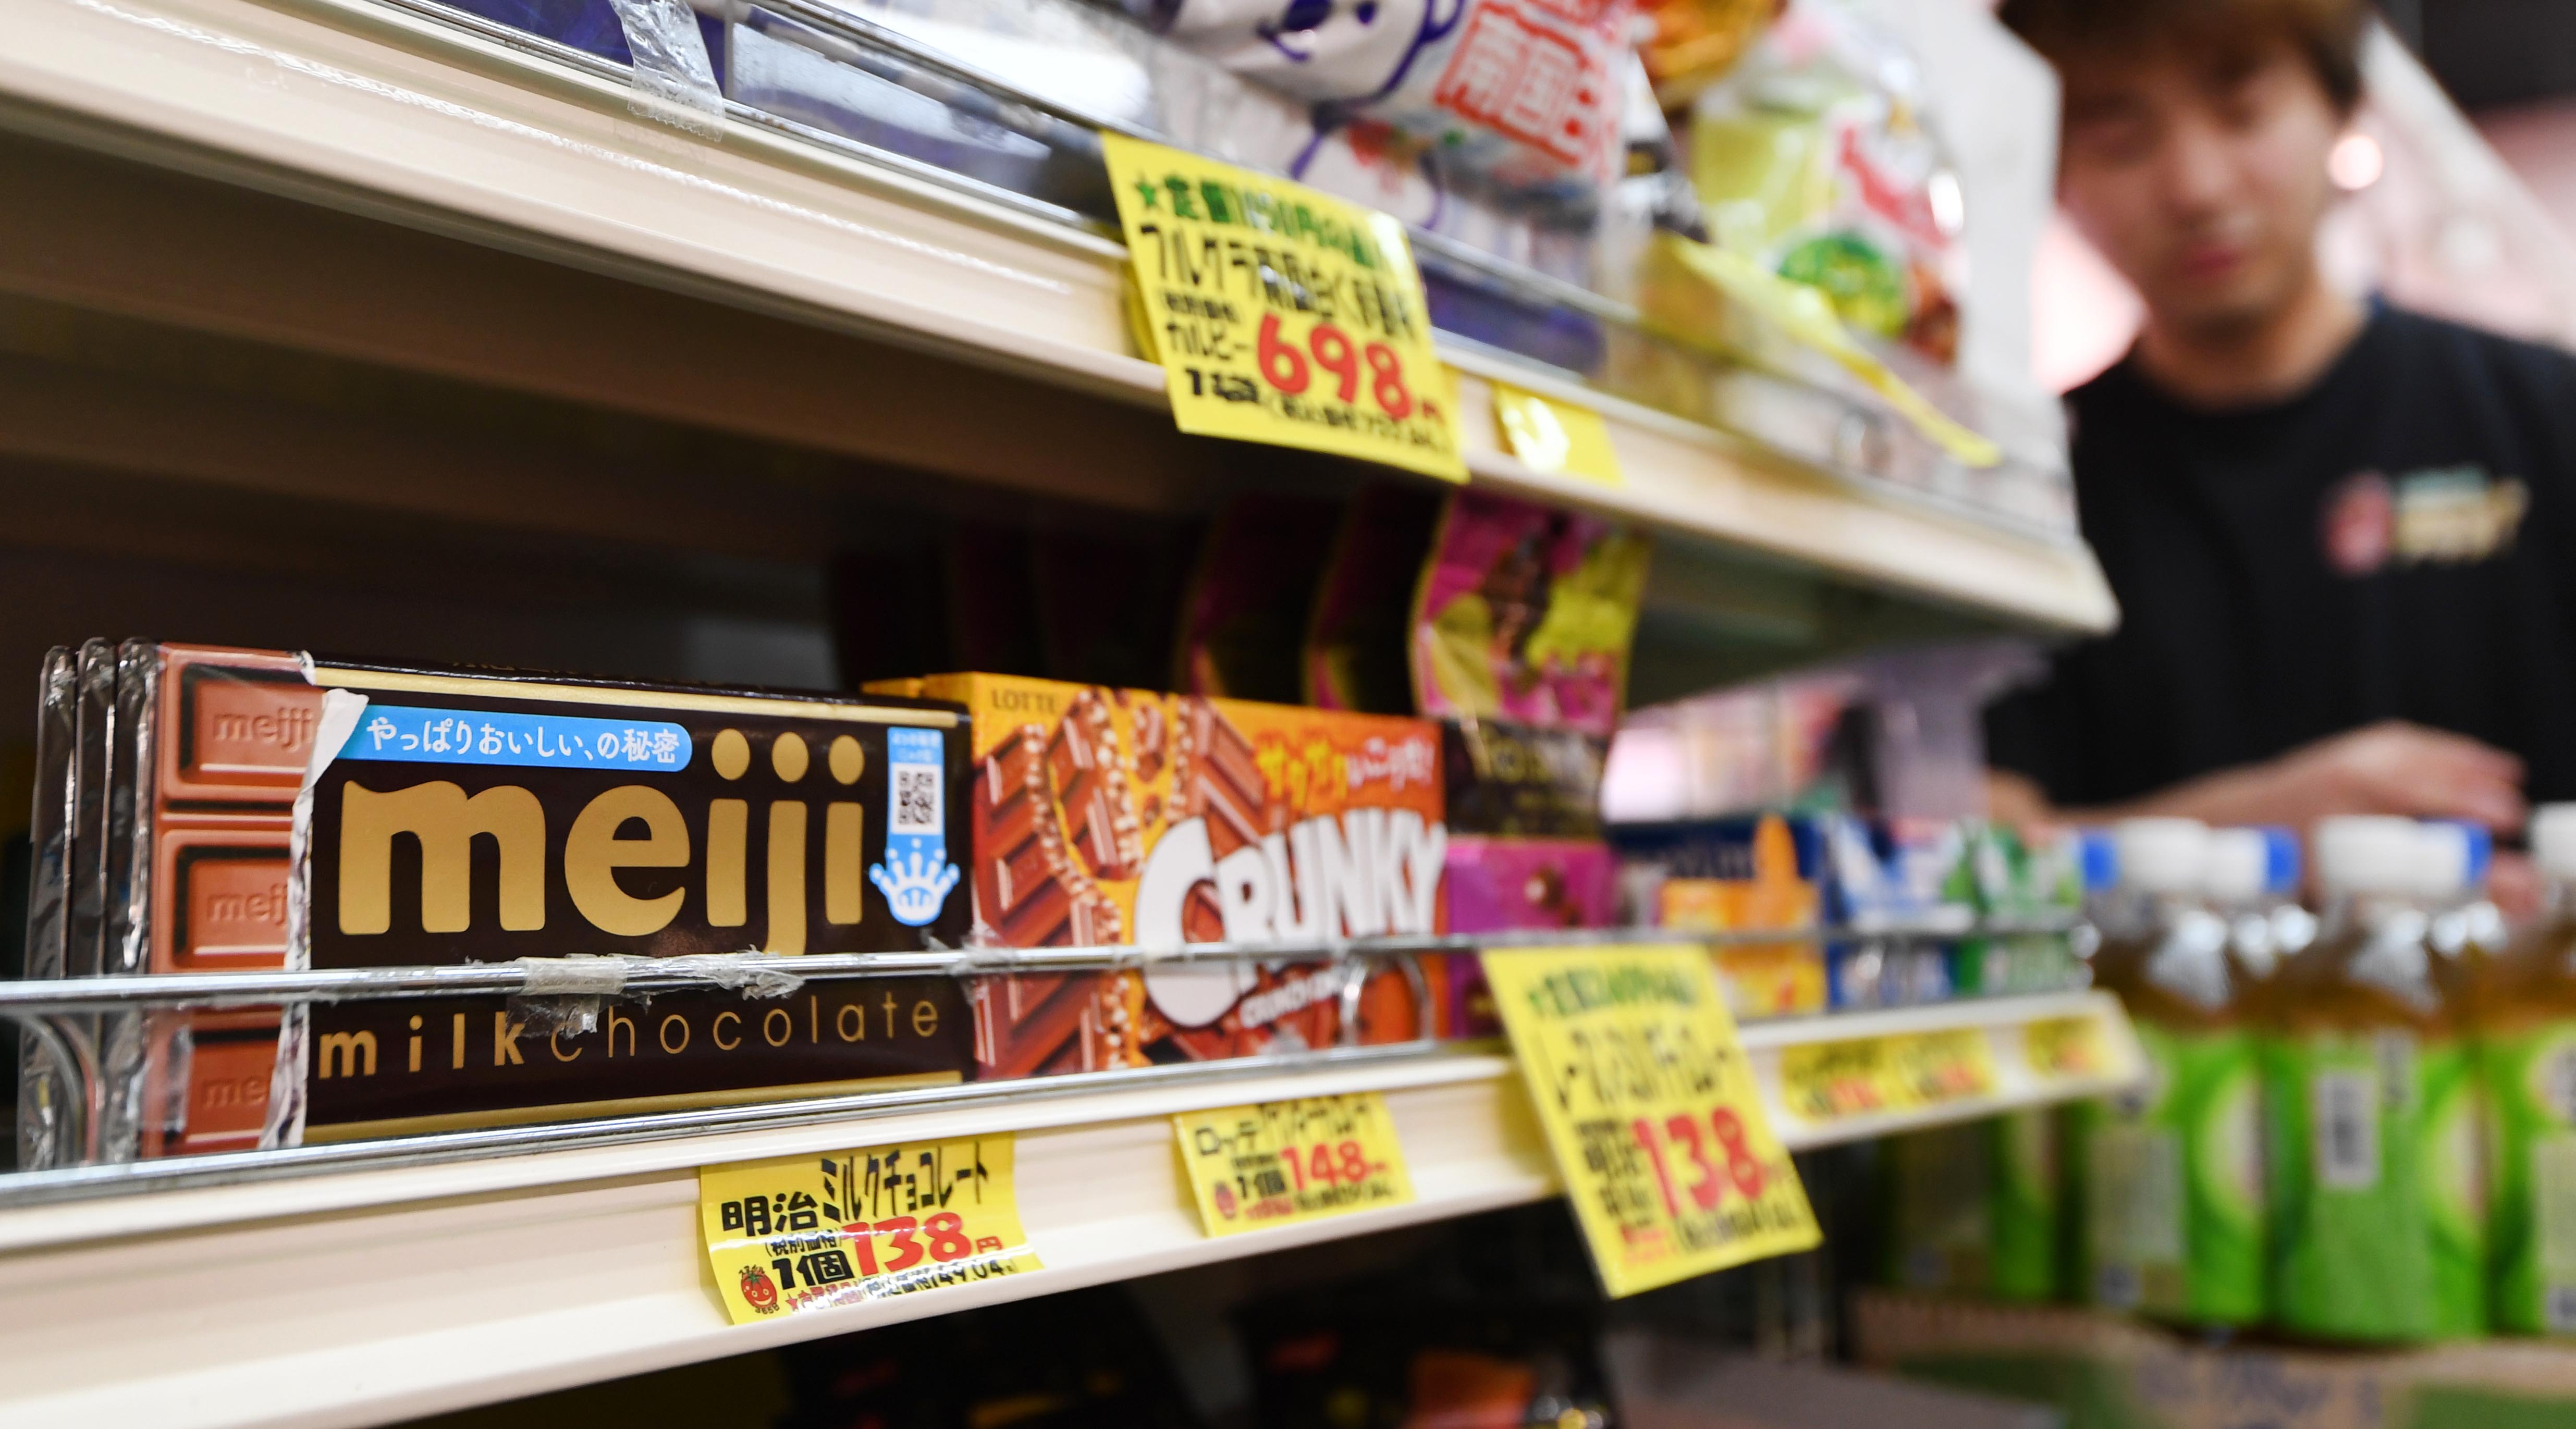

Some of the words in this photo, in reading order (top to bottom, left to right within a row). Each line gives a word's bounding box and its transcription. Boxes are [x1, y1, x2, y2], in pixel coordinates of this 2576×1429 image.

[211, 707, 314, 752] meiji
[366, 716, 680, 763] やっぱりおいしい、の秘密
[338, 728, 865, 957] meiji
[1135, 807, 1447, 1027] CRUNKY
[318, 1011, 525, 1079] milk
[550, 992, 939, 1062] chocolate
[721, 1191, 817, 1237] 明治
